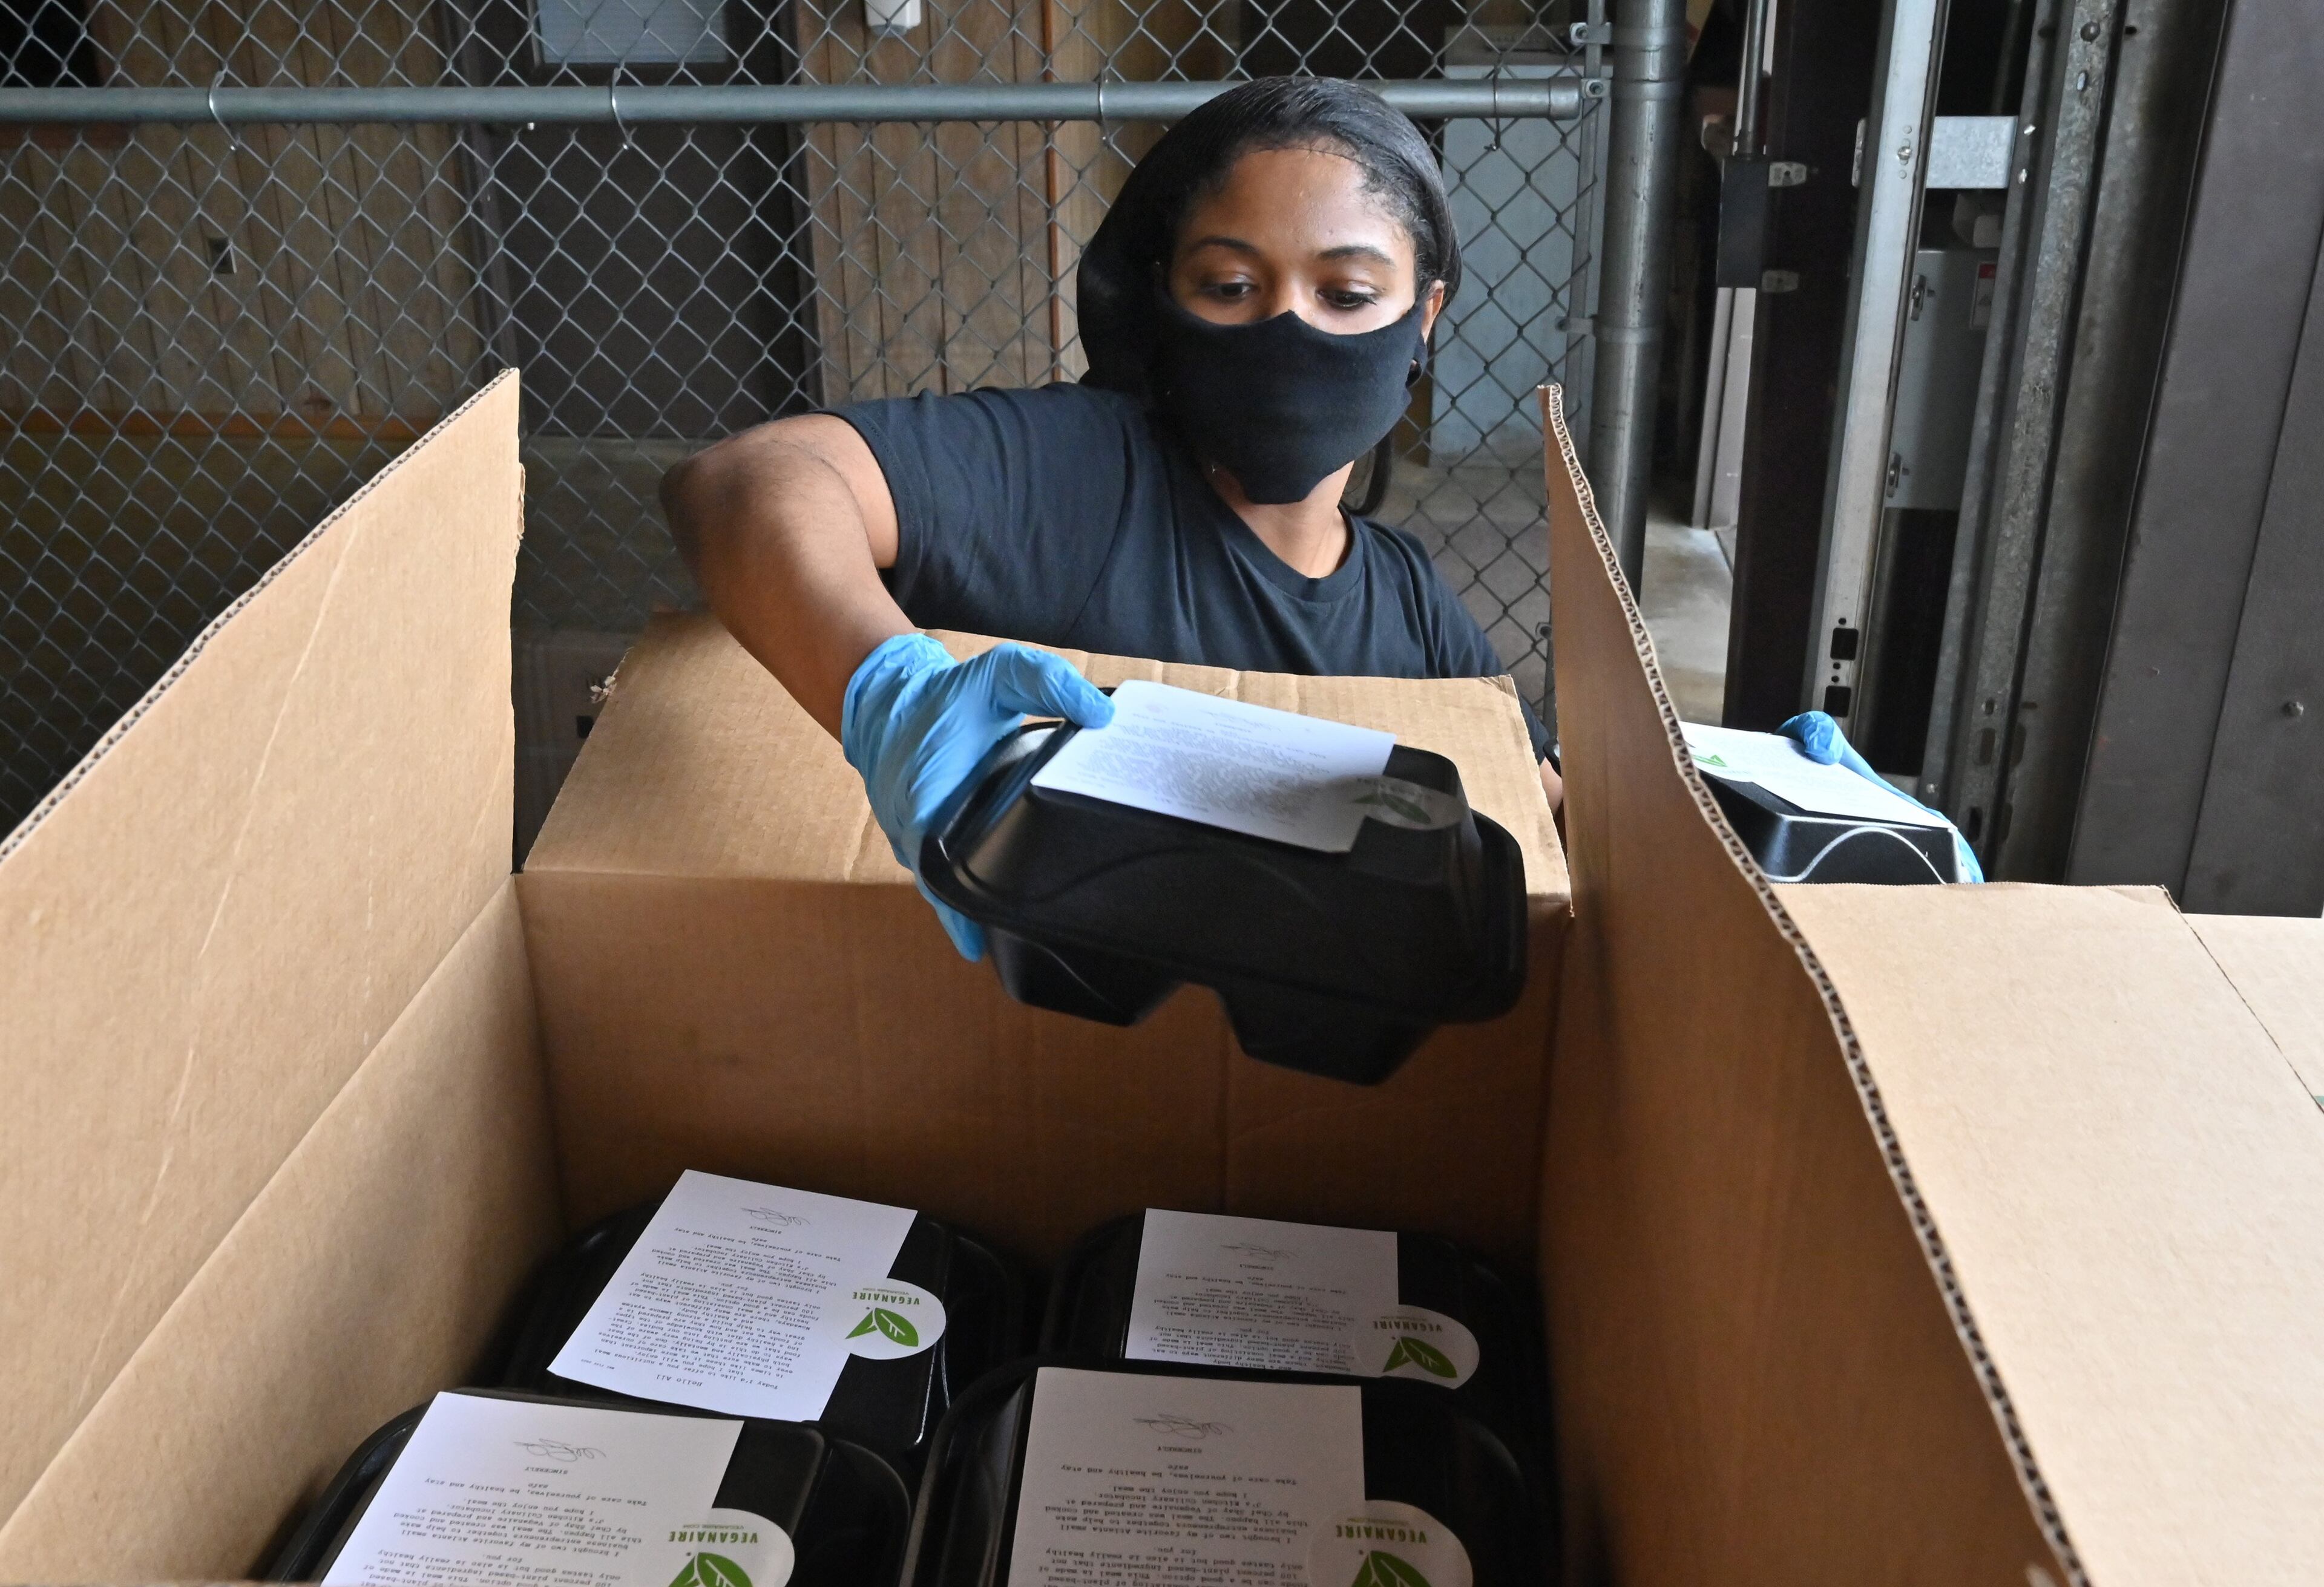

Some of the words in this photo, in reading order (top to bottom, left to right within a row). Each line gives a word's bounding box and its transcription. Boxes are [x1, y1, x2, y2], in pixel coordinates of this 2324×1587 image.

[852, 1292, 920, 1305] VEGANAIRE
[676, 1378, 702, 1386] Hello
[468, 1483, 505, 1492] healthy
[501, 1509, 543, 1518] Culinary
[497, 1517, 545, 1526] Veganaire
[430, 1533, 468, 1542] Atlanta
[466, 1529, 509, 1537] together
[668, 1531, 758, 1543] VEGANAIRE
[1336, 1525, 1427, 1543] VEGANAIRE
[472, 1537, 515, 1546] favorite
[513, 1534, 581, 1543] entrepreneurs
[585, 1541, 627, 1549] business
[375, 1550, 415, 1560] healthy
[424, 1565, 484, 1575] ingredients
[367, 1574, 428, 1585] plant-based
[488, 1571, 548, 1581] plant-based
